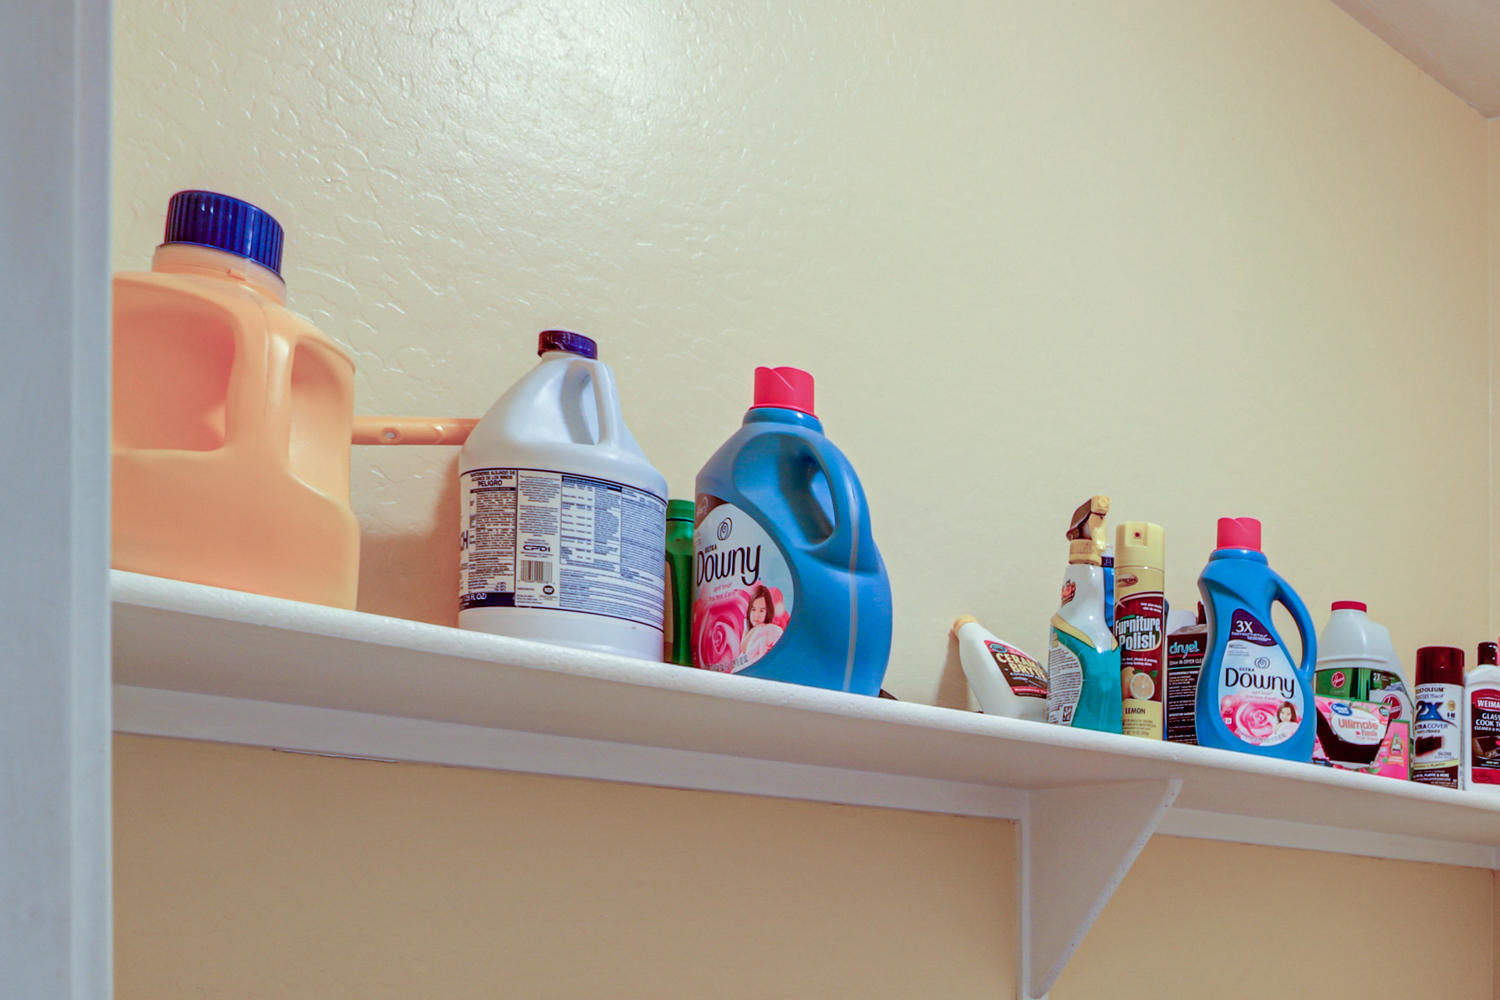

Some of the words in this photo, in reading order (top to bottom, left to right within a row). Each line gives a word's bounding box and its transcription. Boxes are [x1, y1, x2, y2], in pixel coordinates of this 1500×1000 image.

[696, 544, 761, 587] Downy
[1115, 616, 1161, 637] Furniture
[1235, 620, 1253, 633] 3X
[1119, 632, 1157, 651] Polish
[1225, 667, 1295, 700] Downy
[1125, 707, 1146, 715] LEMON
[1416, 700, 1443, 721] 2X
[1475, 719, 1495, 727] COOK
